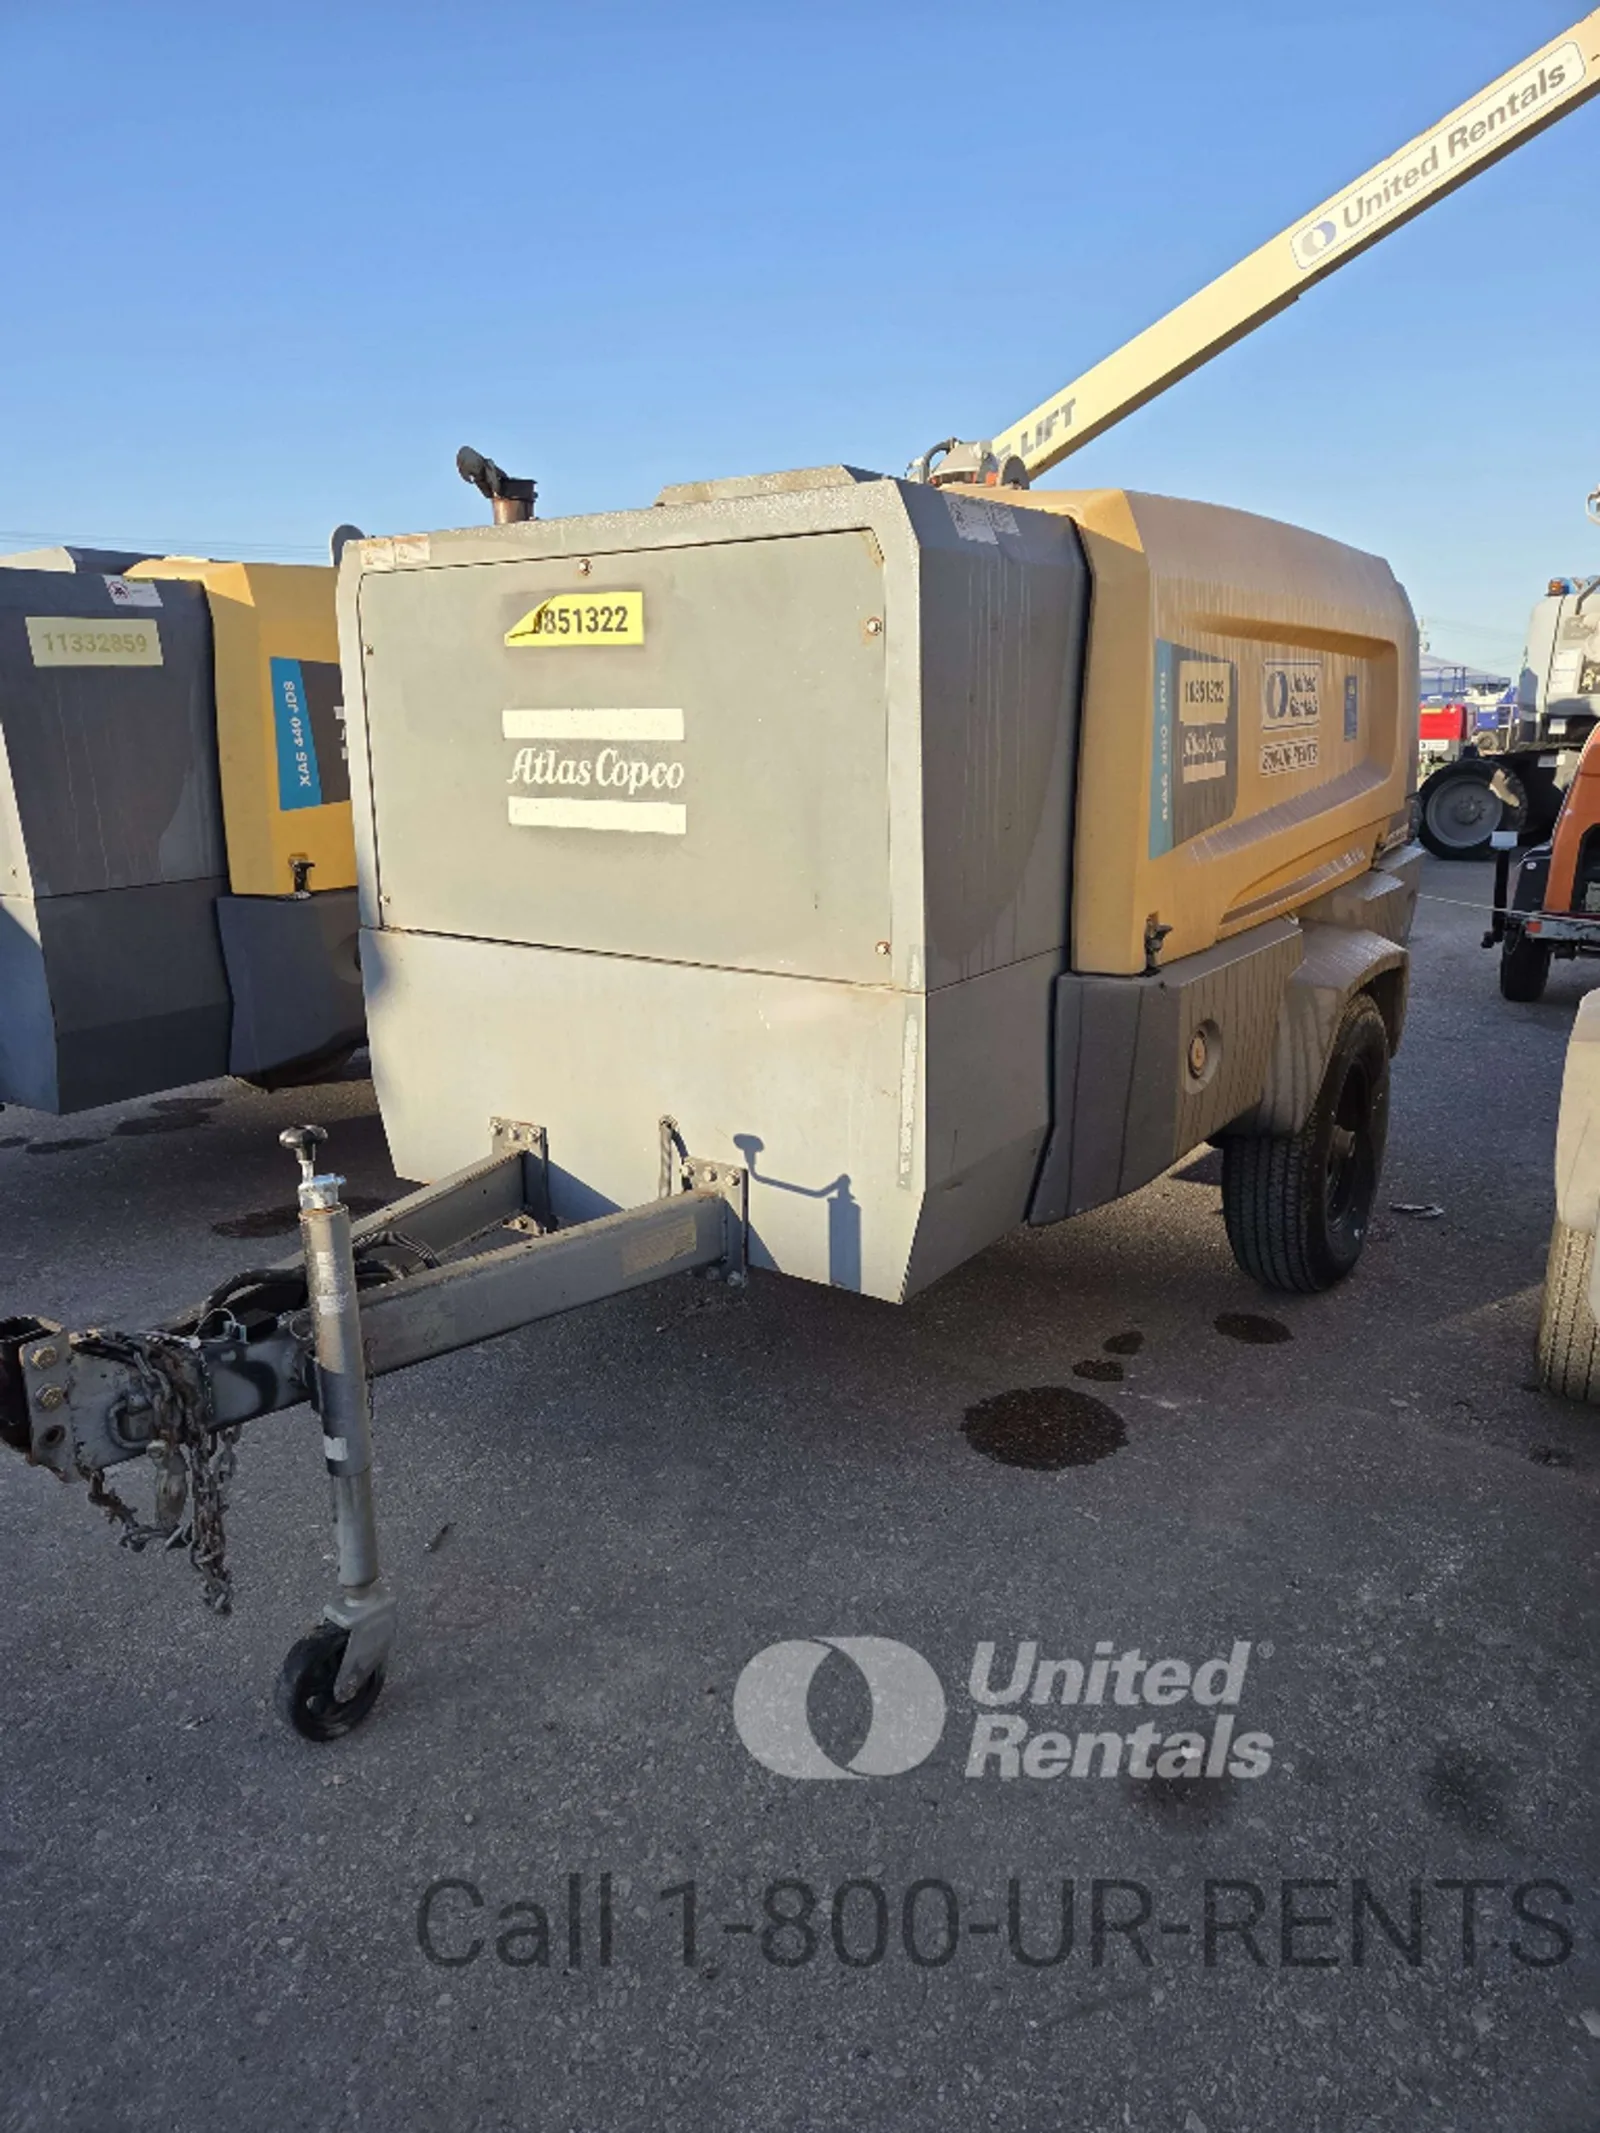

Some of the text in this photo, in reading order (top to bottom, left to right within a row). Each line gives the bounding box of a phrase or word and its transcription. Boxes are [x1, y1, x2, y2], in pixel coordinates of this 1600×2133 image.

[1343, 64, 1566, 229] United Rentals
[1021, 397, 1076, 458] LIFT
[43, 632, 147, 653] 11332859
[289, 716, 304, 747] 440
[507, 747, 685, 794] Atlas Copco
